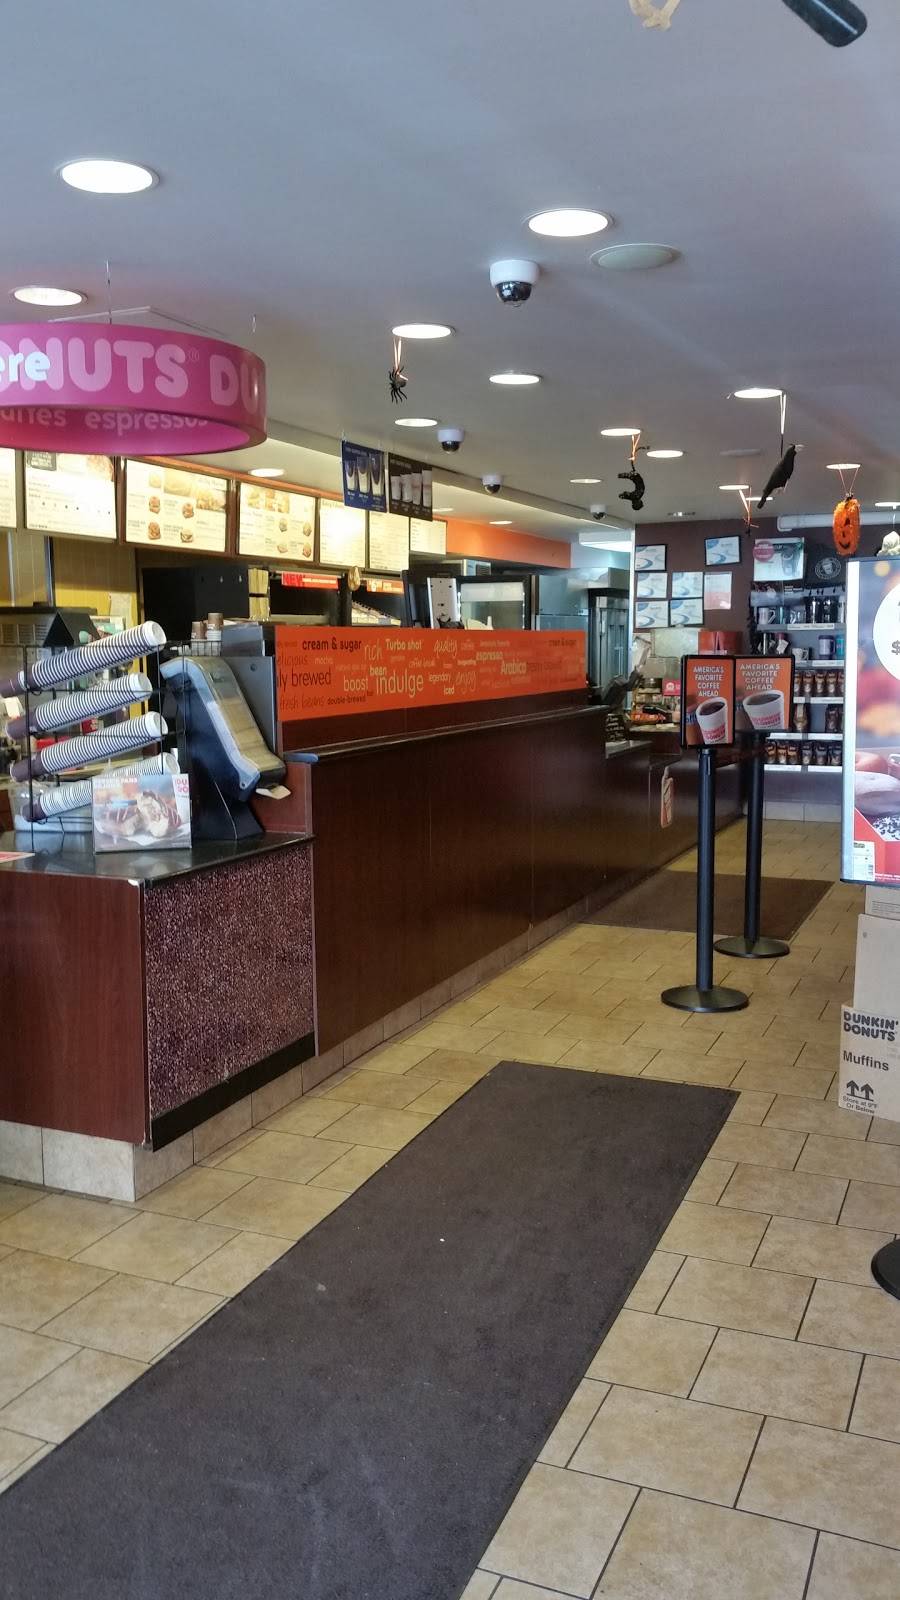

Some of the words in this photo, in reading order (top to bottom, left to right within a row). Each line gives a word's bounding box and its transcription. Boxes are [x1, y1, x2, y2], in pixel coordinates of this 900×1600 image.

[302, 639, 329, 651] cream
[331, 636, 338, 650] &
[339, 639, 362, 653] sugar
[385, 638, 406, 651] Turbo
[407, 639, 422, 650] shot
[291, 666, 332, 687] brewed
[369, 664, 387, 676] bean
[343, 675, 369, 692] boost
[376, 668, 424, 698] indulge
[745, 676, 775, 684] COFFEE
[843, 1010, 899, 1031] DUNKIN'
[843, 1023, 896, 1042] DONUTS
[842, 1050, 890, 1072] Muffins
